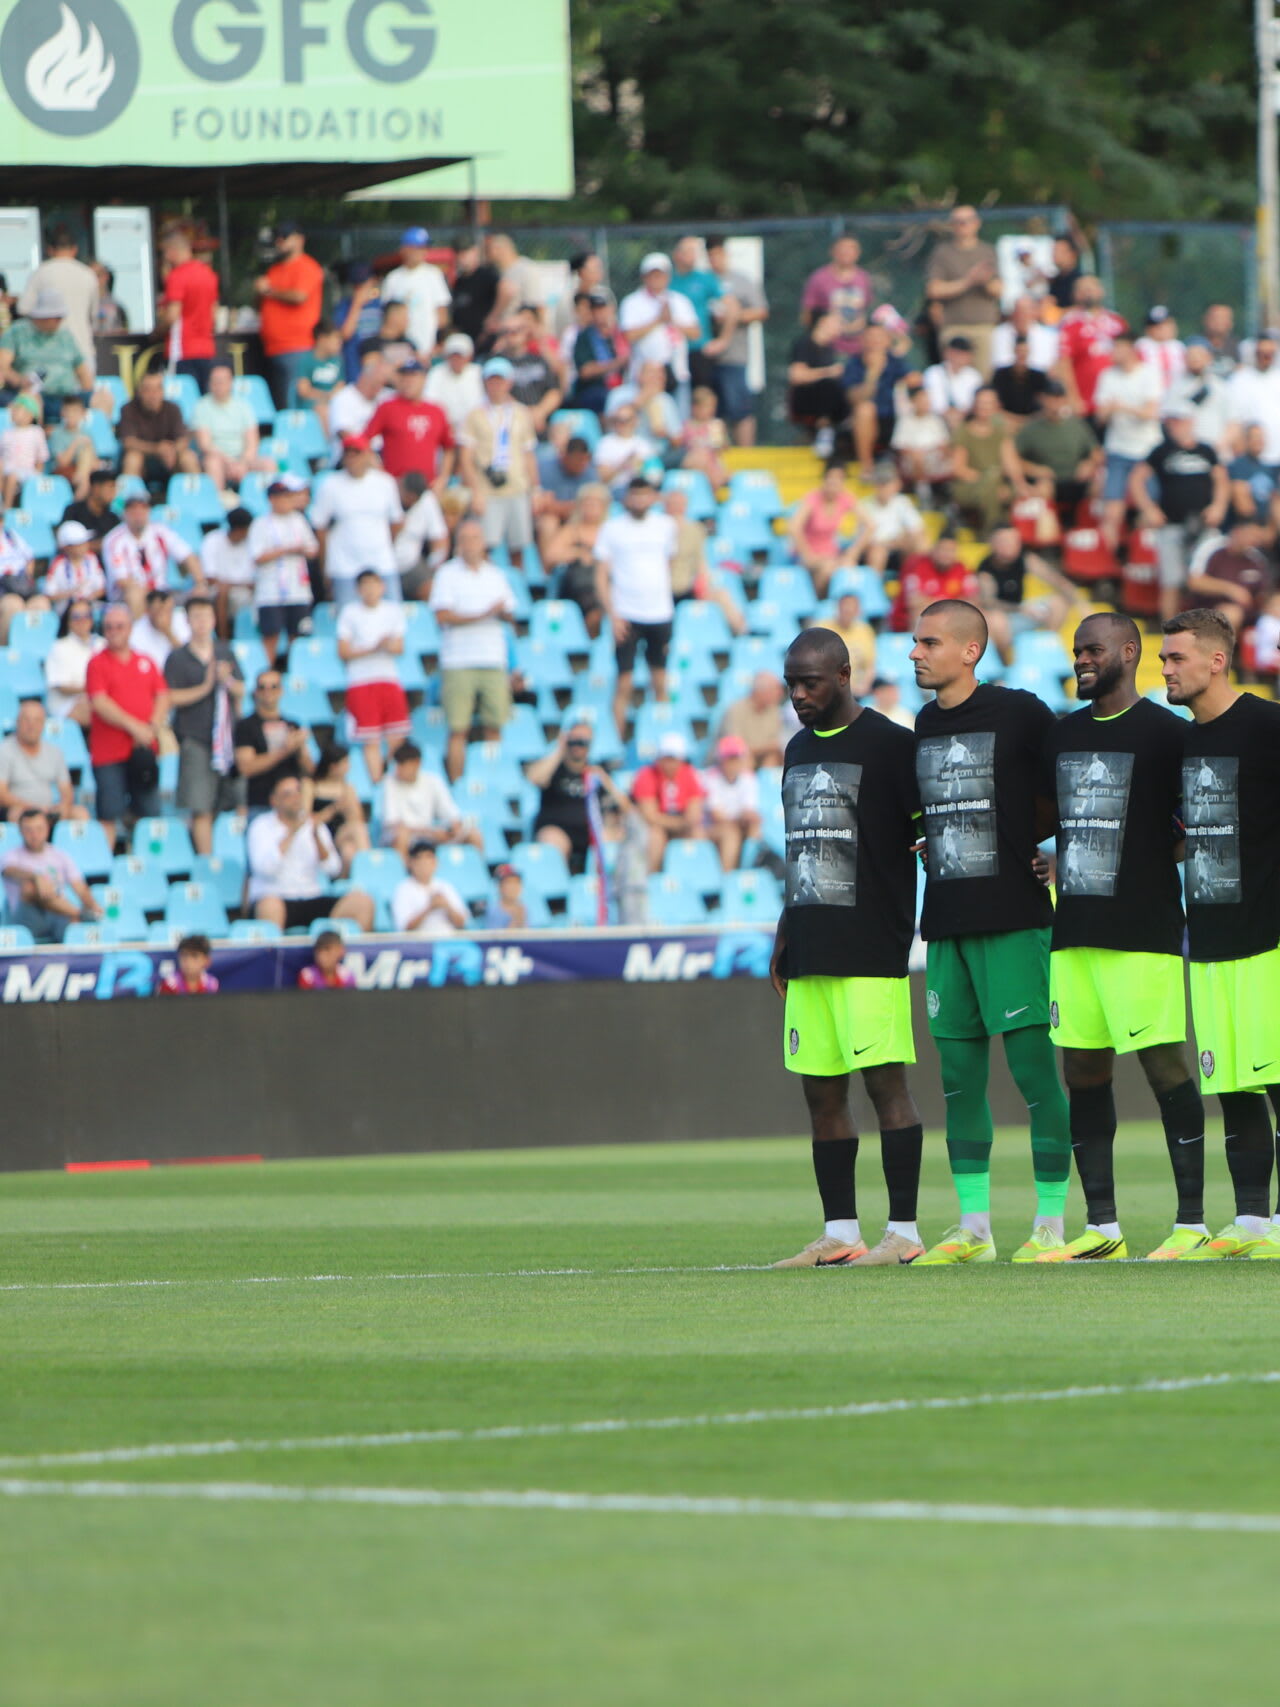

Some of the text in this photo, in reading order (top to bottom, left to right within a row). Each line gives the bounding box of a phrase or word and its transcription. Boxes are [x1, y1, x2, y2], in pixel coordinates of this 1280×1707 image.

[170, 0, 439, 85] GFG
[171, 106, 444, 142] FOUNDATION
[816, 827, 852, 839] niciodată!
[622, 930, 776, 982] MrB
